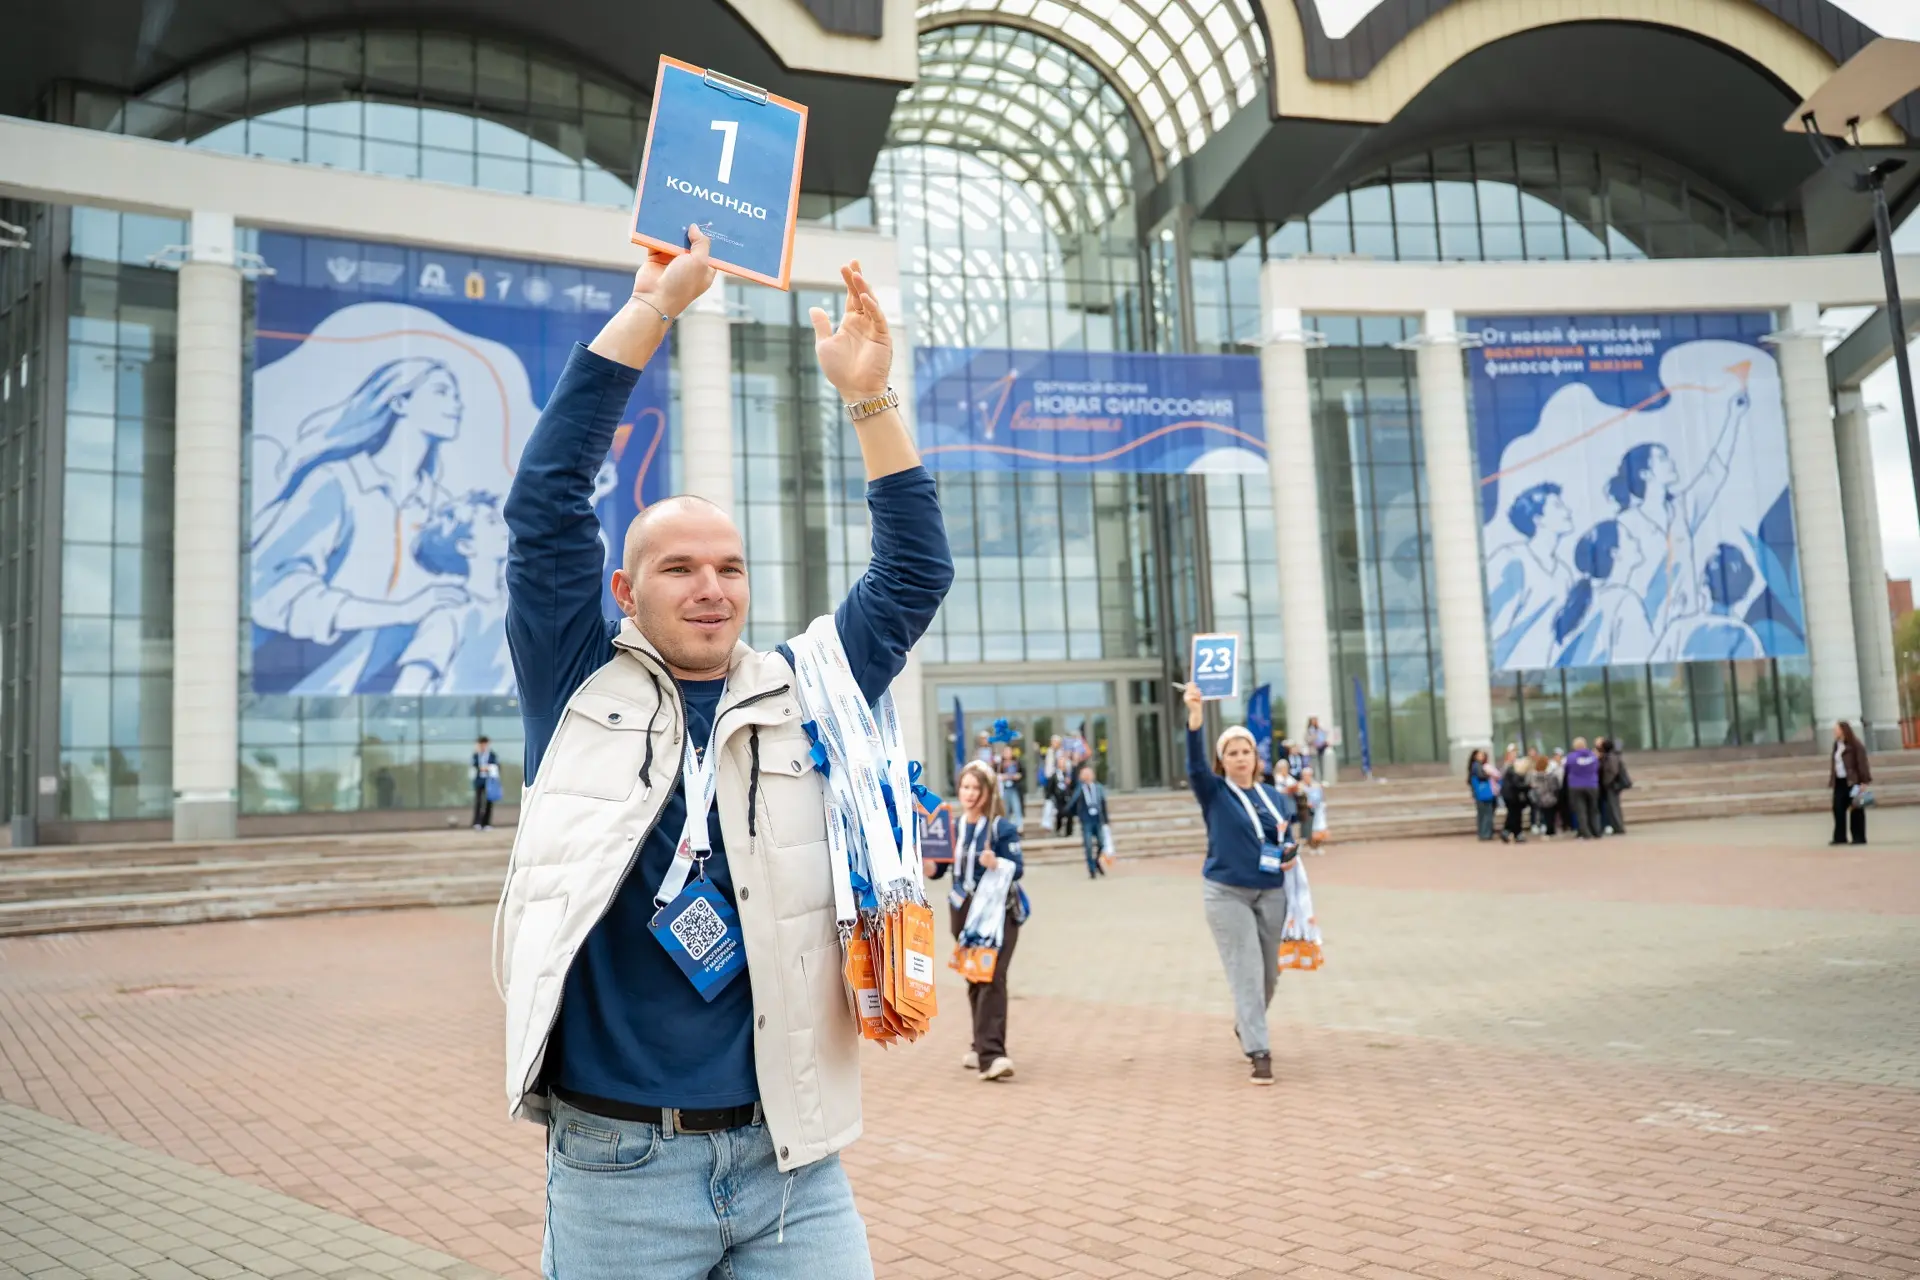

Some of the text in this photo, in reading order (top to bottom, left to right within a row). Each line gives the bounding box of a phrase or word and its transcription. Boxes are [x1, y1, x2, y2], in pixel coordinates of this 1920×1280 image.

[711, 120, 738, 184] 1
[666, 176, 767, 220] команда
[1034, 395, 1101, 414] НОВАЯ
[1105, 397, 1233, 417] ФИЛОСОФИЯ
[1197, 647, 1231, 673] 23
[920, 816, 945, 839] 14
[702, 936, 731, 965] ПРОГРАММА
[708, 939, 737, 968] МАТЕРИАЛЫ
[713, 950, 735, 971] ФОРУМА
